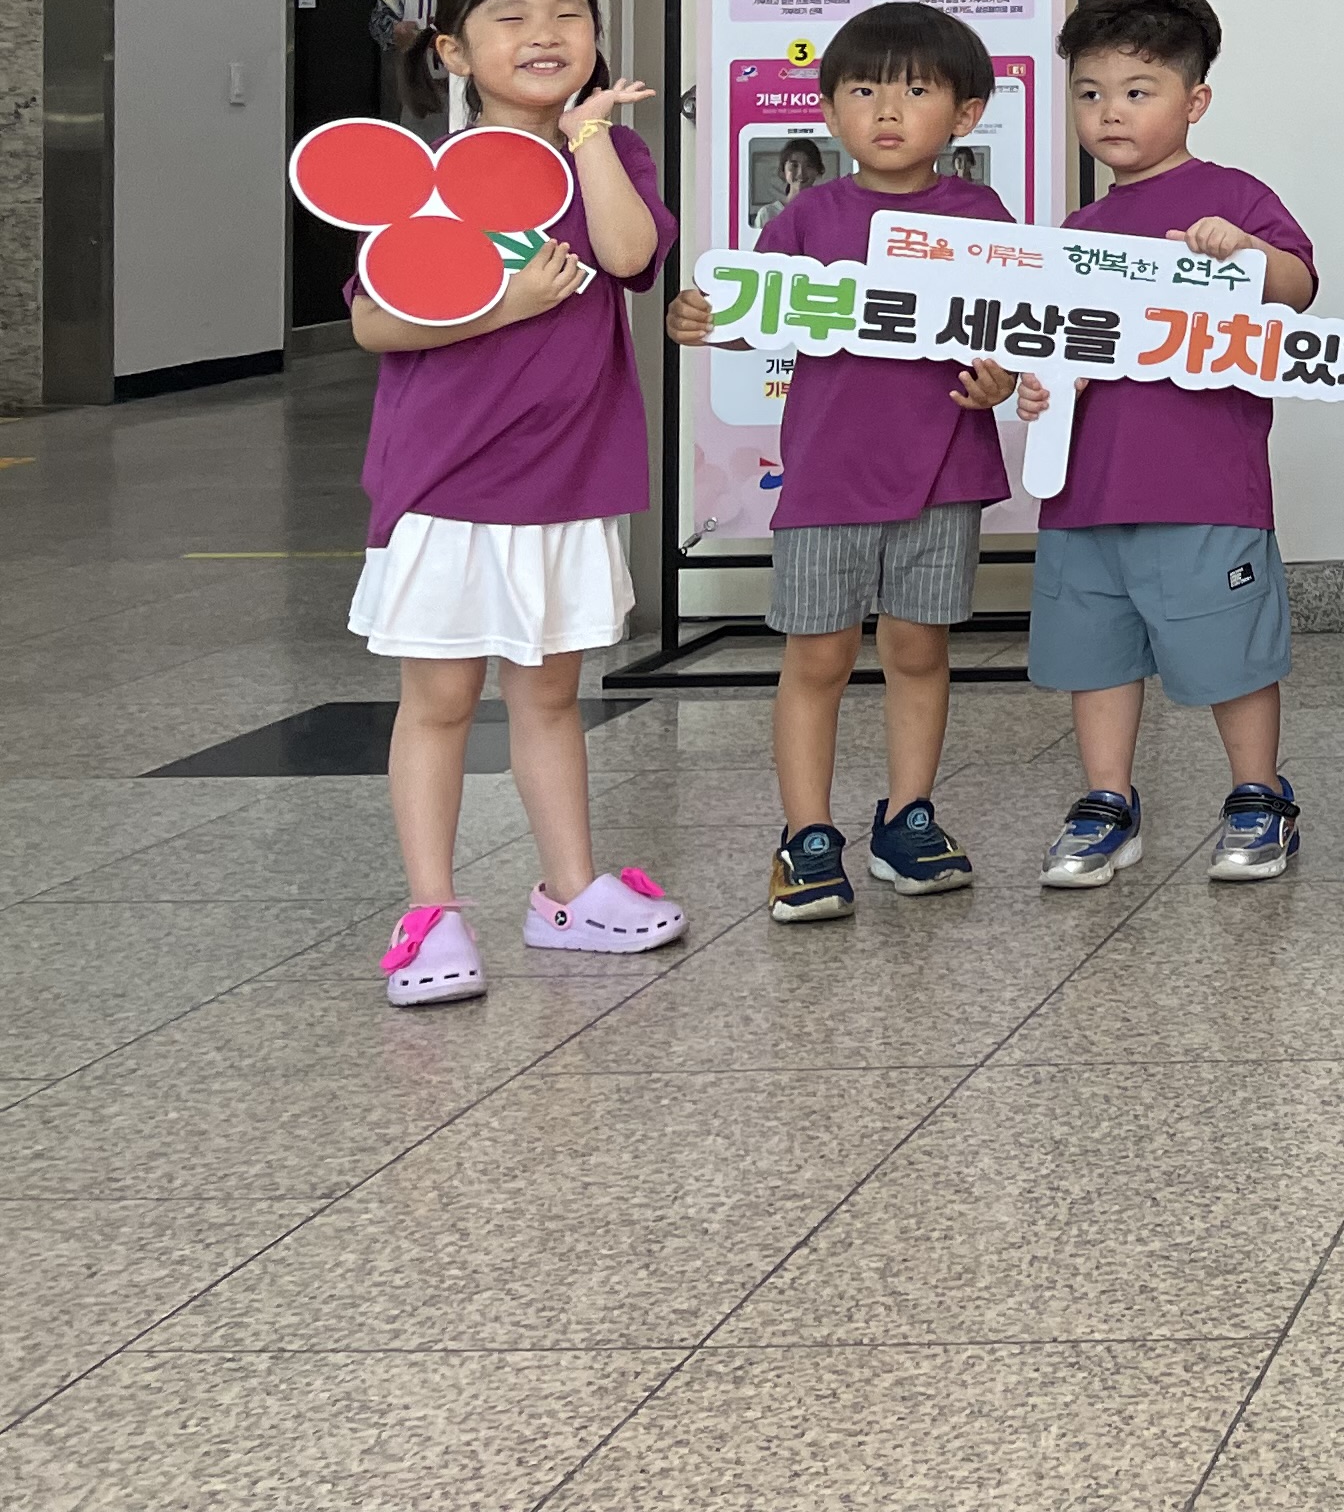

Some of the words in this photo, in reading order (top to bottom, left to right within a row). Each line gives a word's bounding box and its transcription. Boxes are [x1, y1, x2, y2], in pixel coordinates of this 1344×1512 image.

[794, 43, 808, 61] 3
[756, 93, 788, 106] 기부!
[790, 93, 823, 106] KIO
[886, 225, 955, 262] 꿈을
[967, 241, 1044, 270] 이루는
[1062, 243, 1160, 282] 행복한
[1172, 254, 1252, 292] 연수
[711, 265, 918, 346] 기부로
[934, 296, 1121, 365] 세상을
